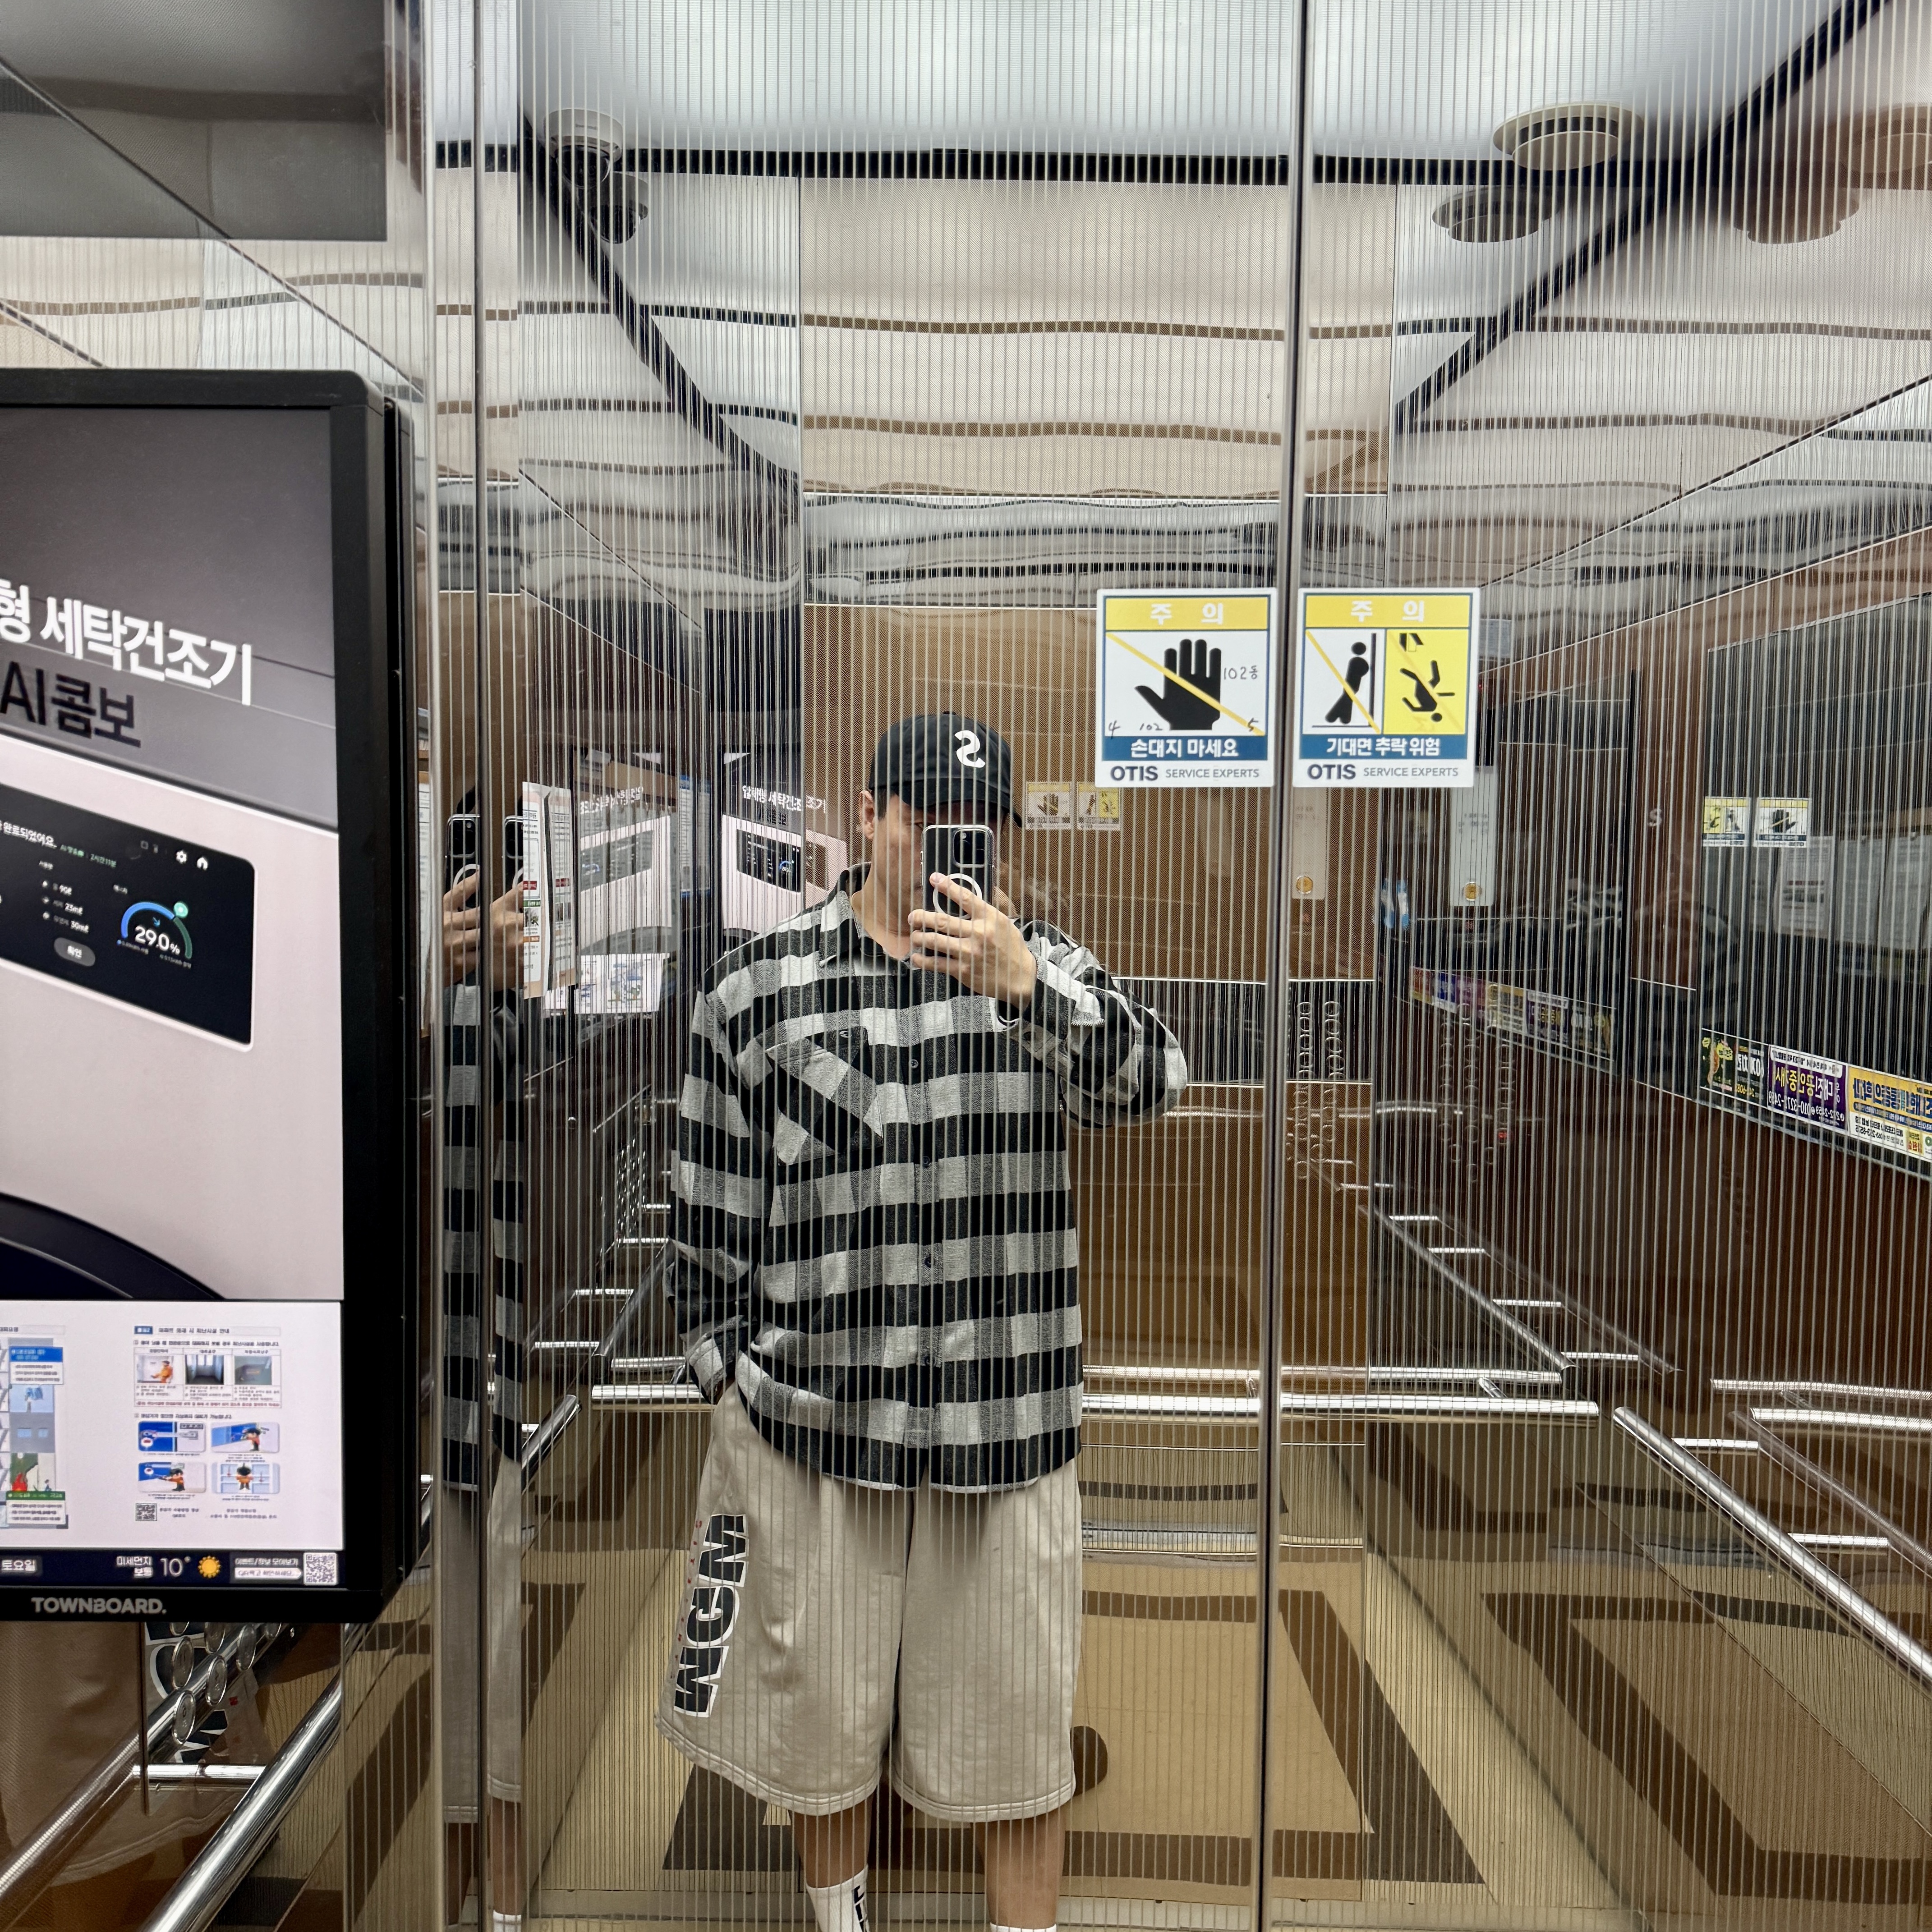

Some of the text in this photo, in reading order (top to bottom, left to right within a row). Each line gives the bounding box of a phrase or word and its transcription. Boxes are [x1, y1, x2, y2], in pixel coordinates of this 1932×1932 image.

[1150, 602, 1224, 625] 주 의
[1350, 599, 1425, 623] 주 의
[40, 597, 252, 706] 세탁건조기
[1223, 665, 1258, 680] 102동
[1131, 738, 1239, 758] 손대지 마세요
[1326, 737, 1440, 757] 기대면 추락 위험
[1110, 766, 1260, 781] OTIS SERVICE EXPERTS
[1307, 764, 1458, 780] OTIS SERVICE EXPERTS
[2, 1559, 37, 1572] 토요일
[116, 1556, 152, 1567] 미세먼지
[134, 1567, 153, 1578] 보통
